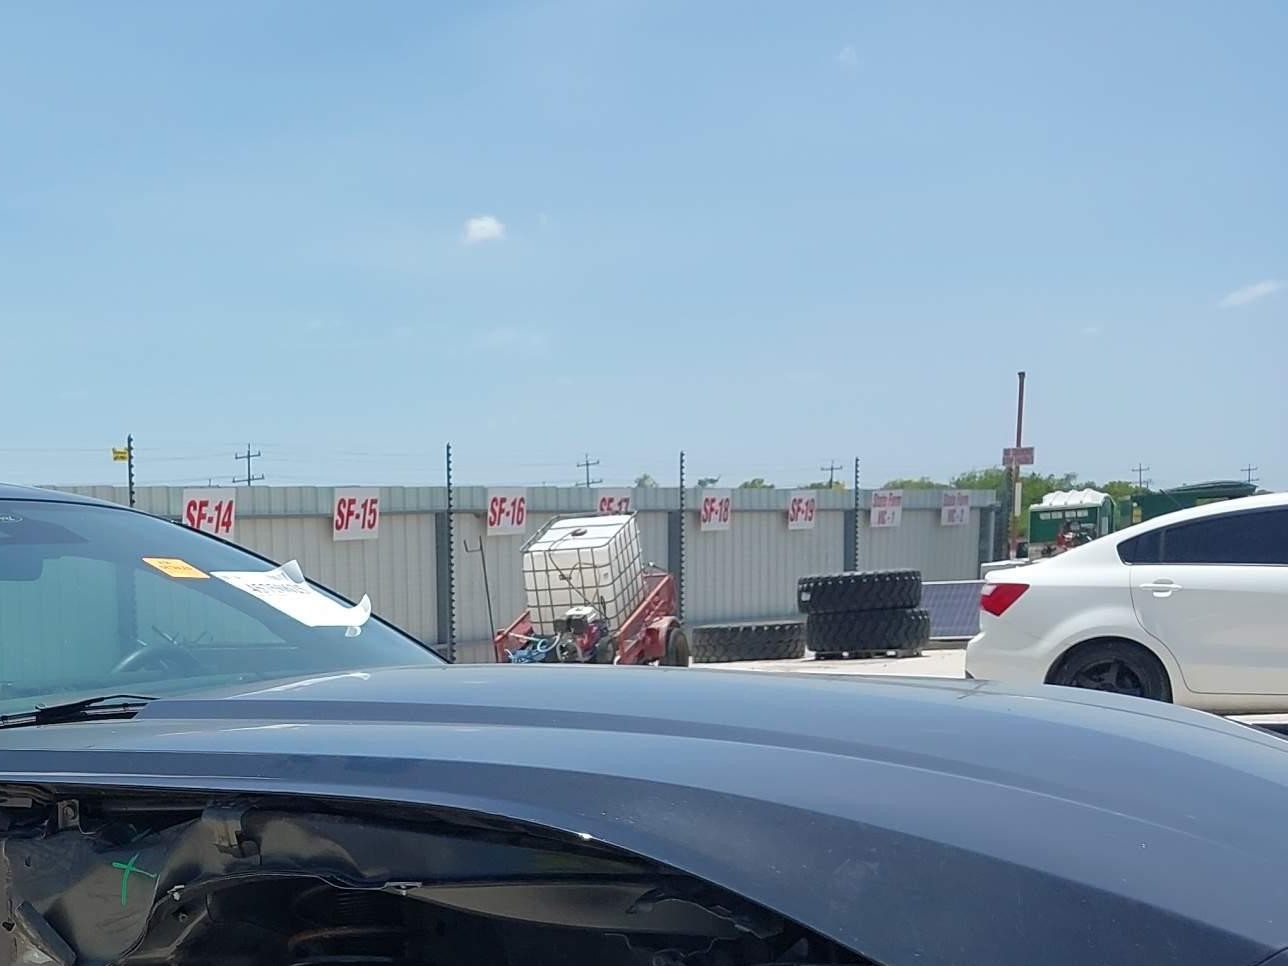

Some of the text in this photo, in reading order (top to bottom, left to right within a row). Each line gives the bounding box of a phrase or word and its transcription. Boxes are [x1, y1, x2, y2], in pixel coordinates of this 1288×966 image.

[186, 500, 233, 533] SF-14
[335, 498, 378, 531] SF-15
[489, 497, 525, 526] SF-16
[702, 497, 729, 522] SF-18
[790, 497, 815, 522] SF-19
